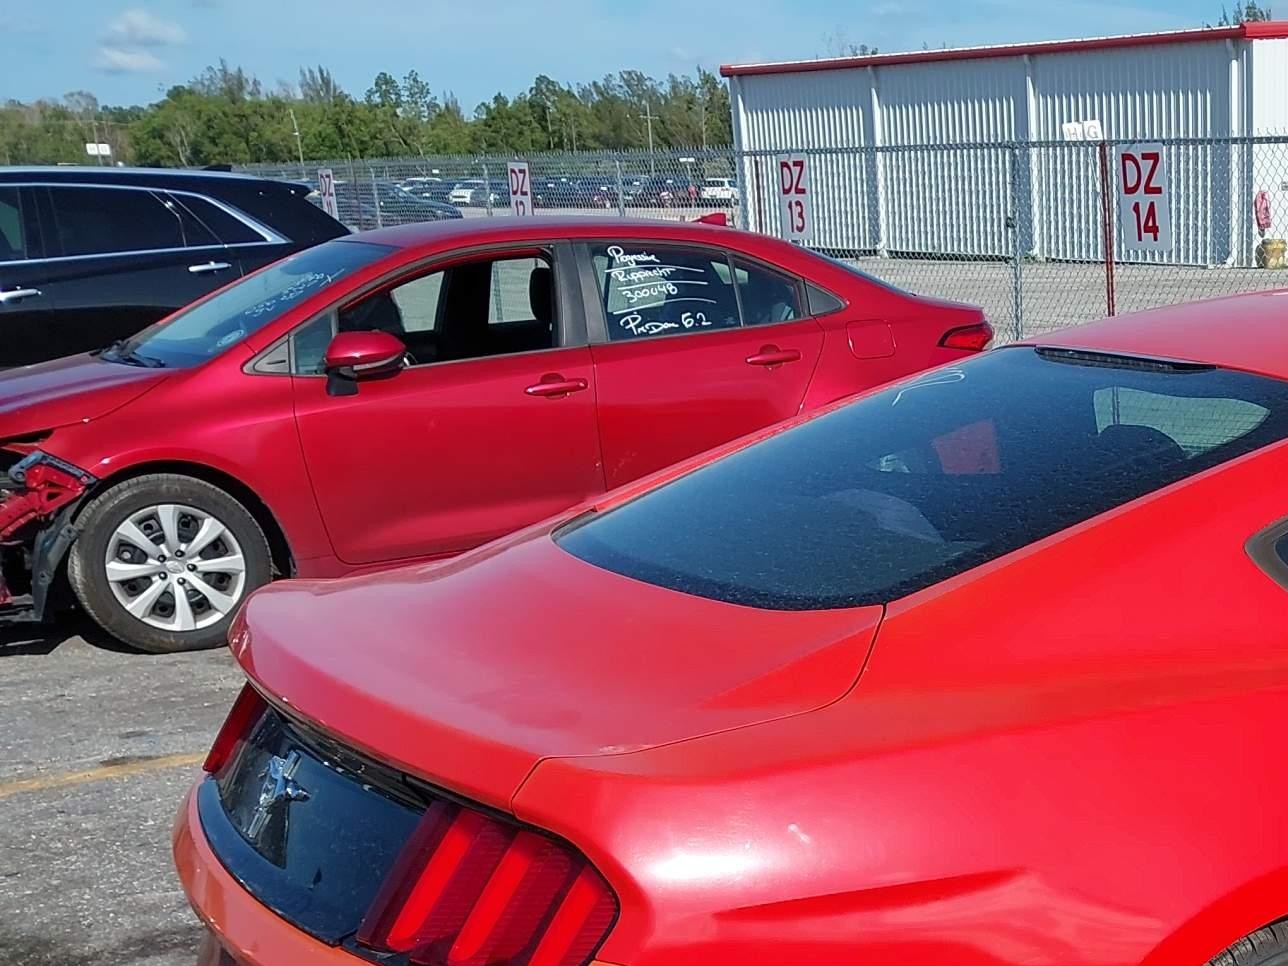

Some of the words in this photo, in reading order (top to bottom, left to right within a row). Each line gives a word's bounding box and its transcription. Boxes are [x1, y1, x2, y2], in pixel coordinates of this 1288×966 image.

[319, 173, 334, 197] DZ
[509, 168, 529, 196] DZ
[780, 160, 806, 195] DZ
[1121, 152, 1163, 195] DZ
[788, 200, 806, 234] 13
[1132, 201, 1160, 242] 14
